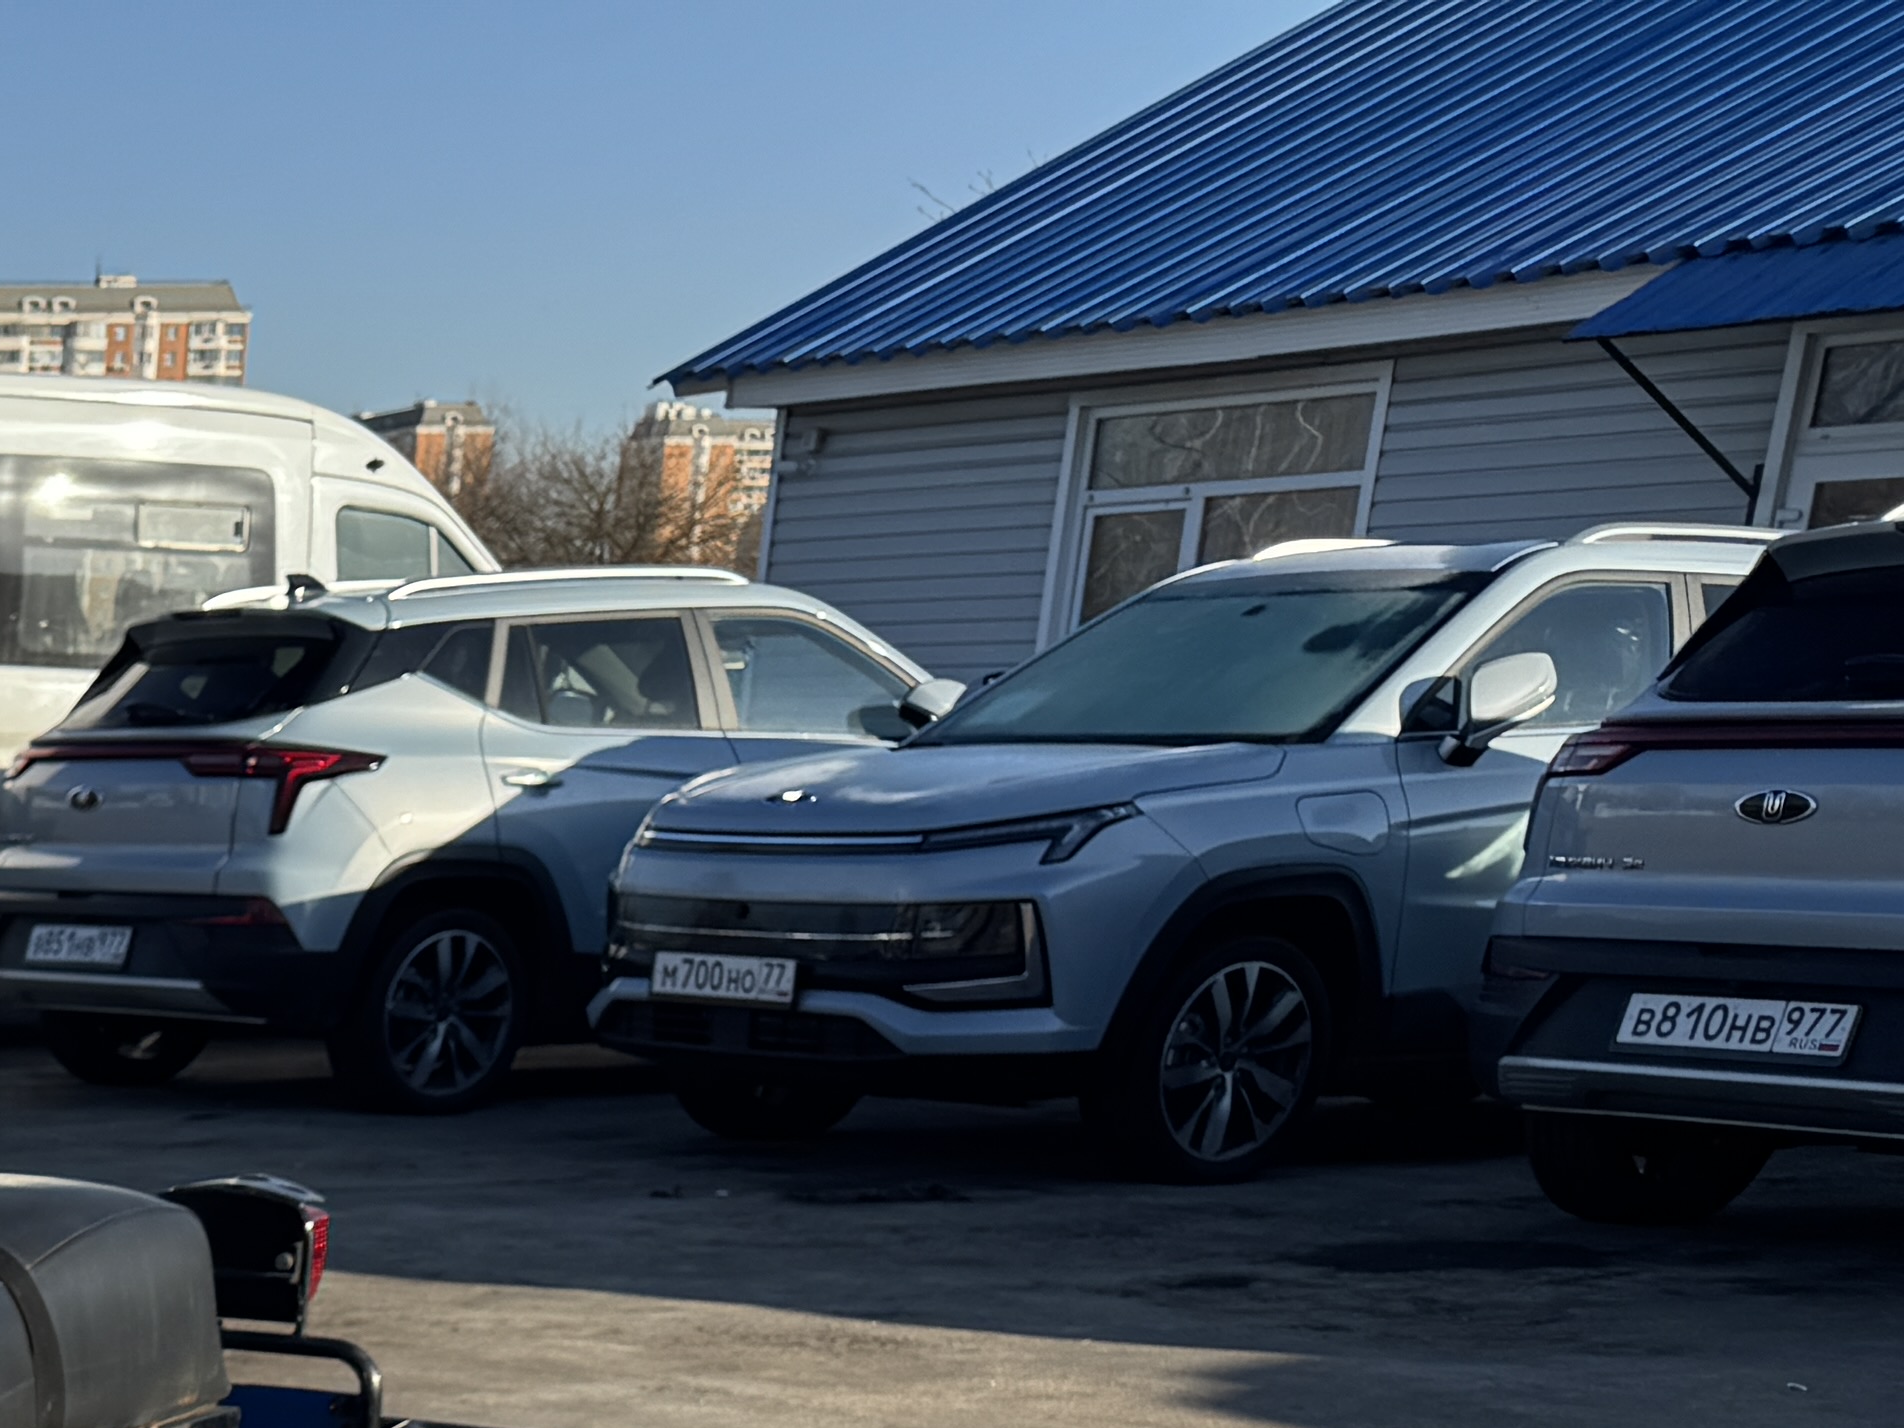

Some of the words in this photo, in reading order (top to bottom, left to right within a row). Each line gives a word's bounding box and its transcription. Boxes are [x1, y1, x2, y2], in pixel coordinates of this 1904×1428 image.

[661, 957, 756, 994] М700НО
[763, 962, 786, 987] 77
[1631, 1001, 1776, 1045] В810НВ
[1785, 1006, 1848, 1039] 977
[1788, 1037, 1818, 1051] RUS
